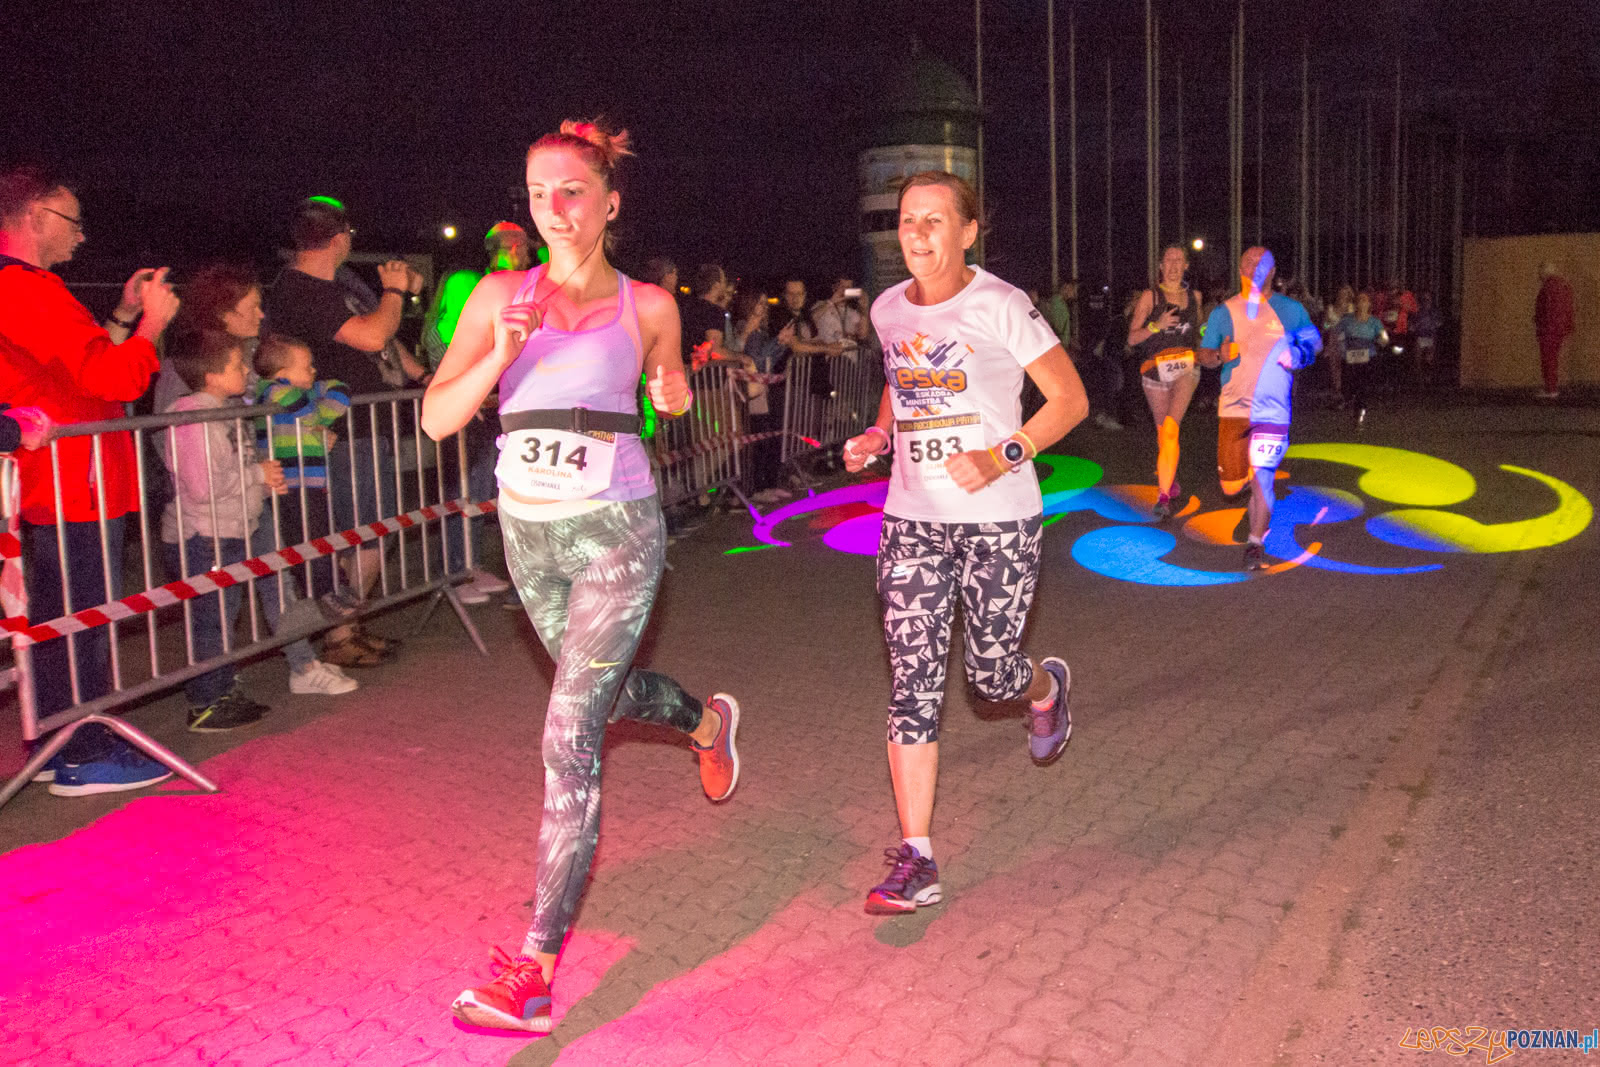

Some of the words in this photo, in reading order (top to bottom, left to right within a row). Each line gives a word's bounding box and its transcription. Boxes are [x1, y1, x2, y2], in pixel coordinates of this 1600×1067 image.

[895, 367, 967, 393] eska
[905, 397, 942, 406] MINISTRA
[520, 437, 588, 472] 314
[909, 436, 964, 463] 583
[1257, 443, 1283, 455] 479
[527, 465, 573, 479] KAROLINA
